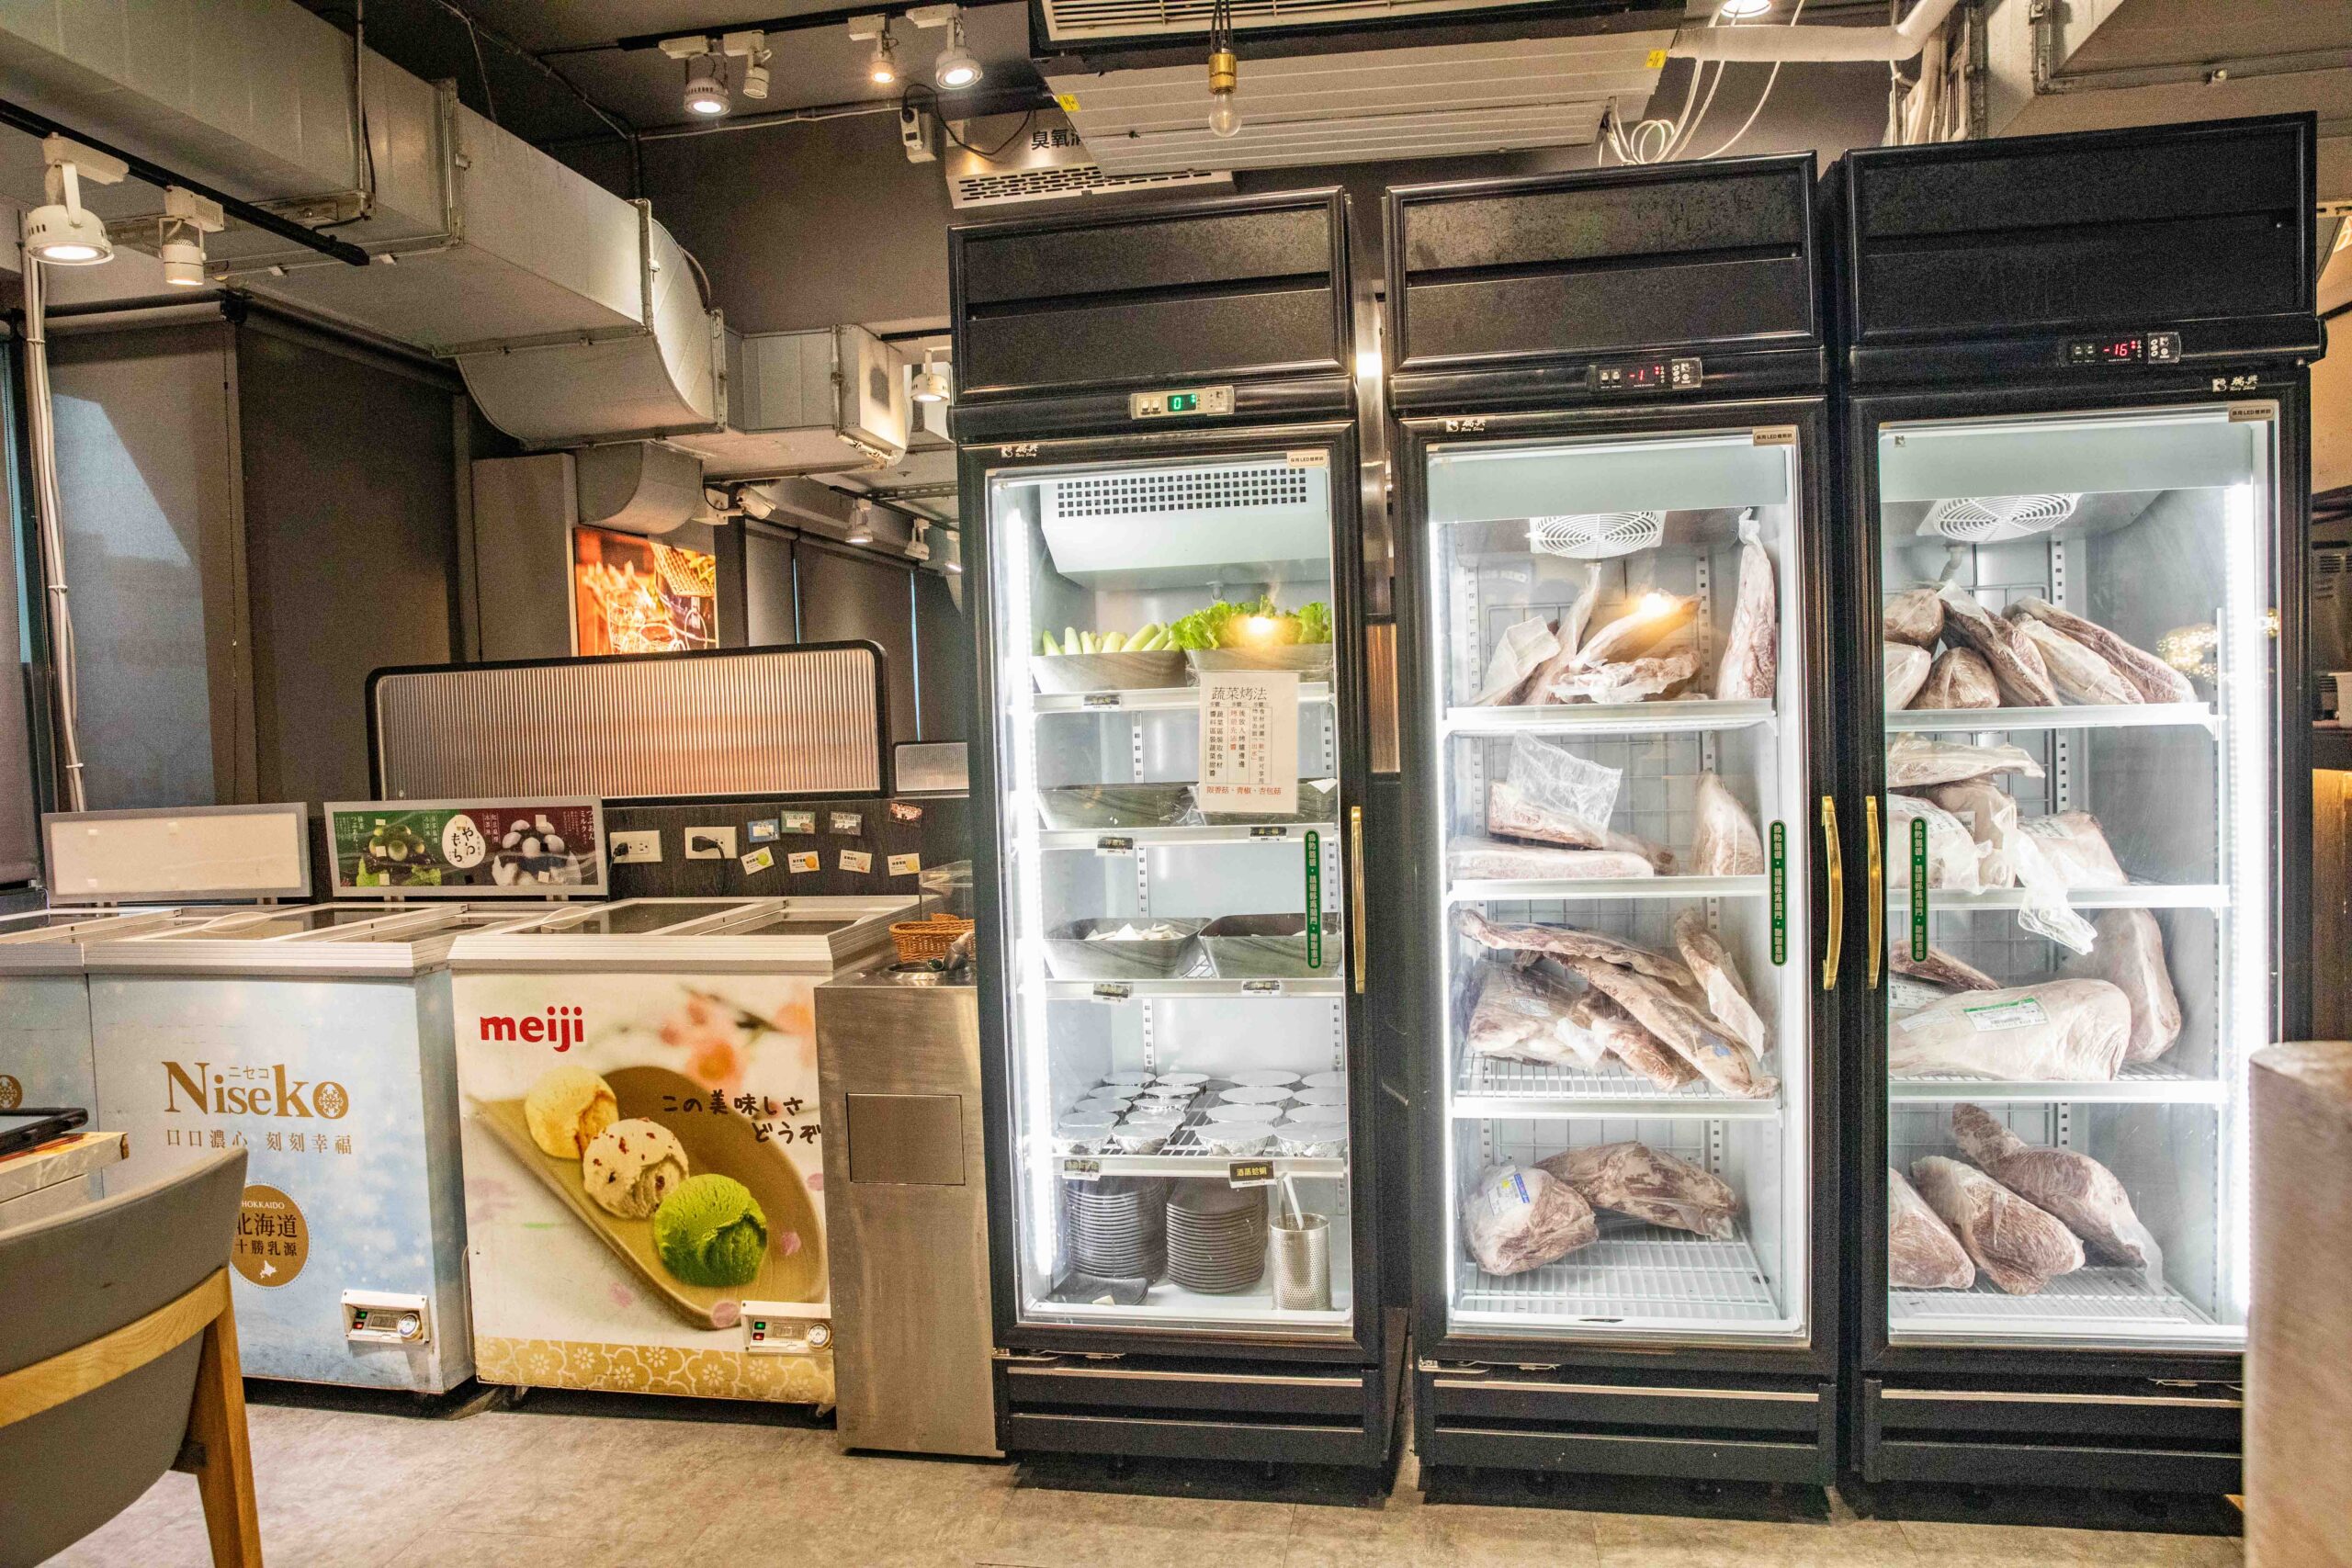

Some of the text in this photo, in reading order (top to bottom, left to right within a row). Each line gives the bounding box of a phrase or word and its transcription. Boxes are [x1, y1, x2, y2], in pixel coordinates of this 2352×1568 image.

[2103, 344, 2128, 356] -16
[1211, 686, 1267, 701] 蔬菜烤法
[480, 1006, 584, 1052] meiji
[229, 1066, 269, 1081] ニセコ
[161, 1061, 349, 1119] Niseko
[662, 1090, 803, 1116] この美味しさ
[167, 1129, 352, 1155] 口口濃心 刻刻幸福
[753, 1122, 822, 1145] どうぞ
[241, 1201, 285, 1210] HOKKAIDO
[235, 1214, 298, 1238] 北海道
[235, 1240, 298, 1257] 十勝乳源
